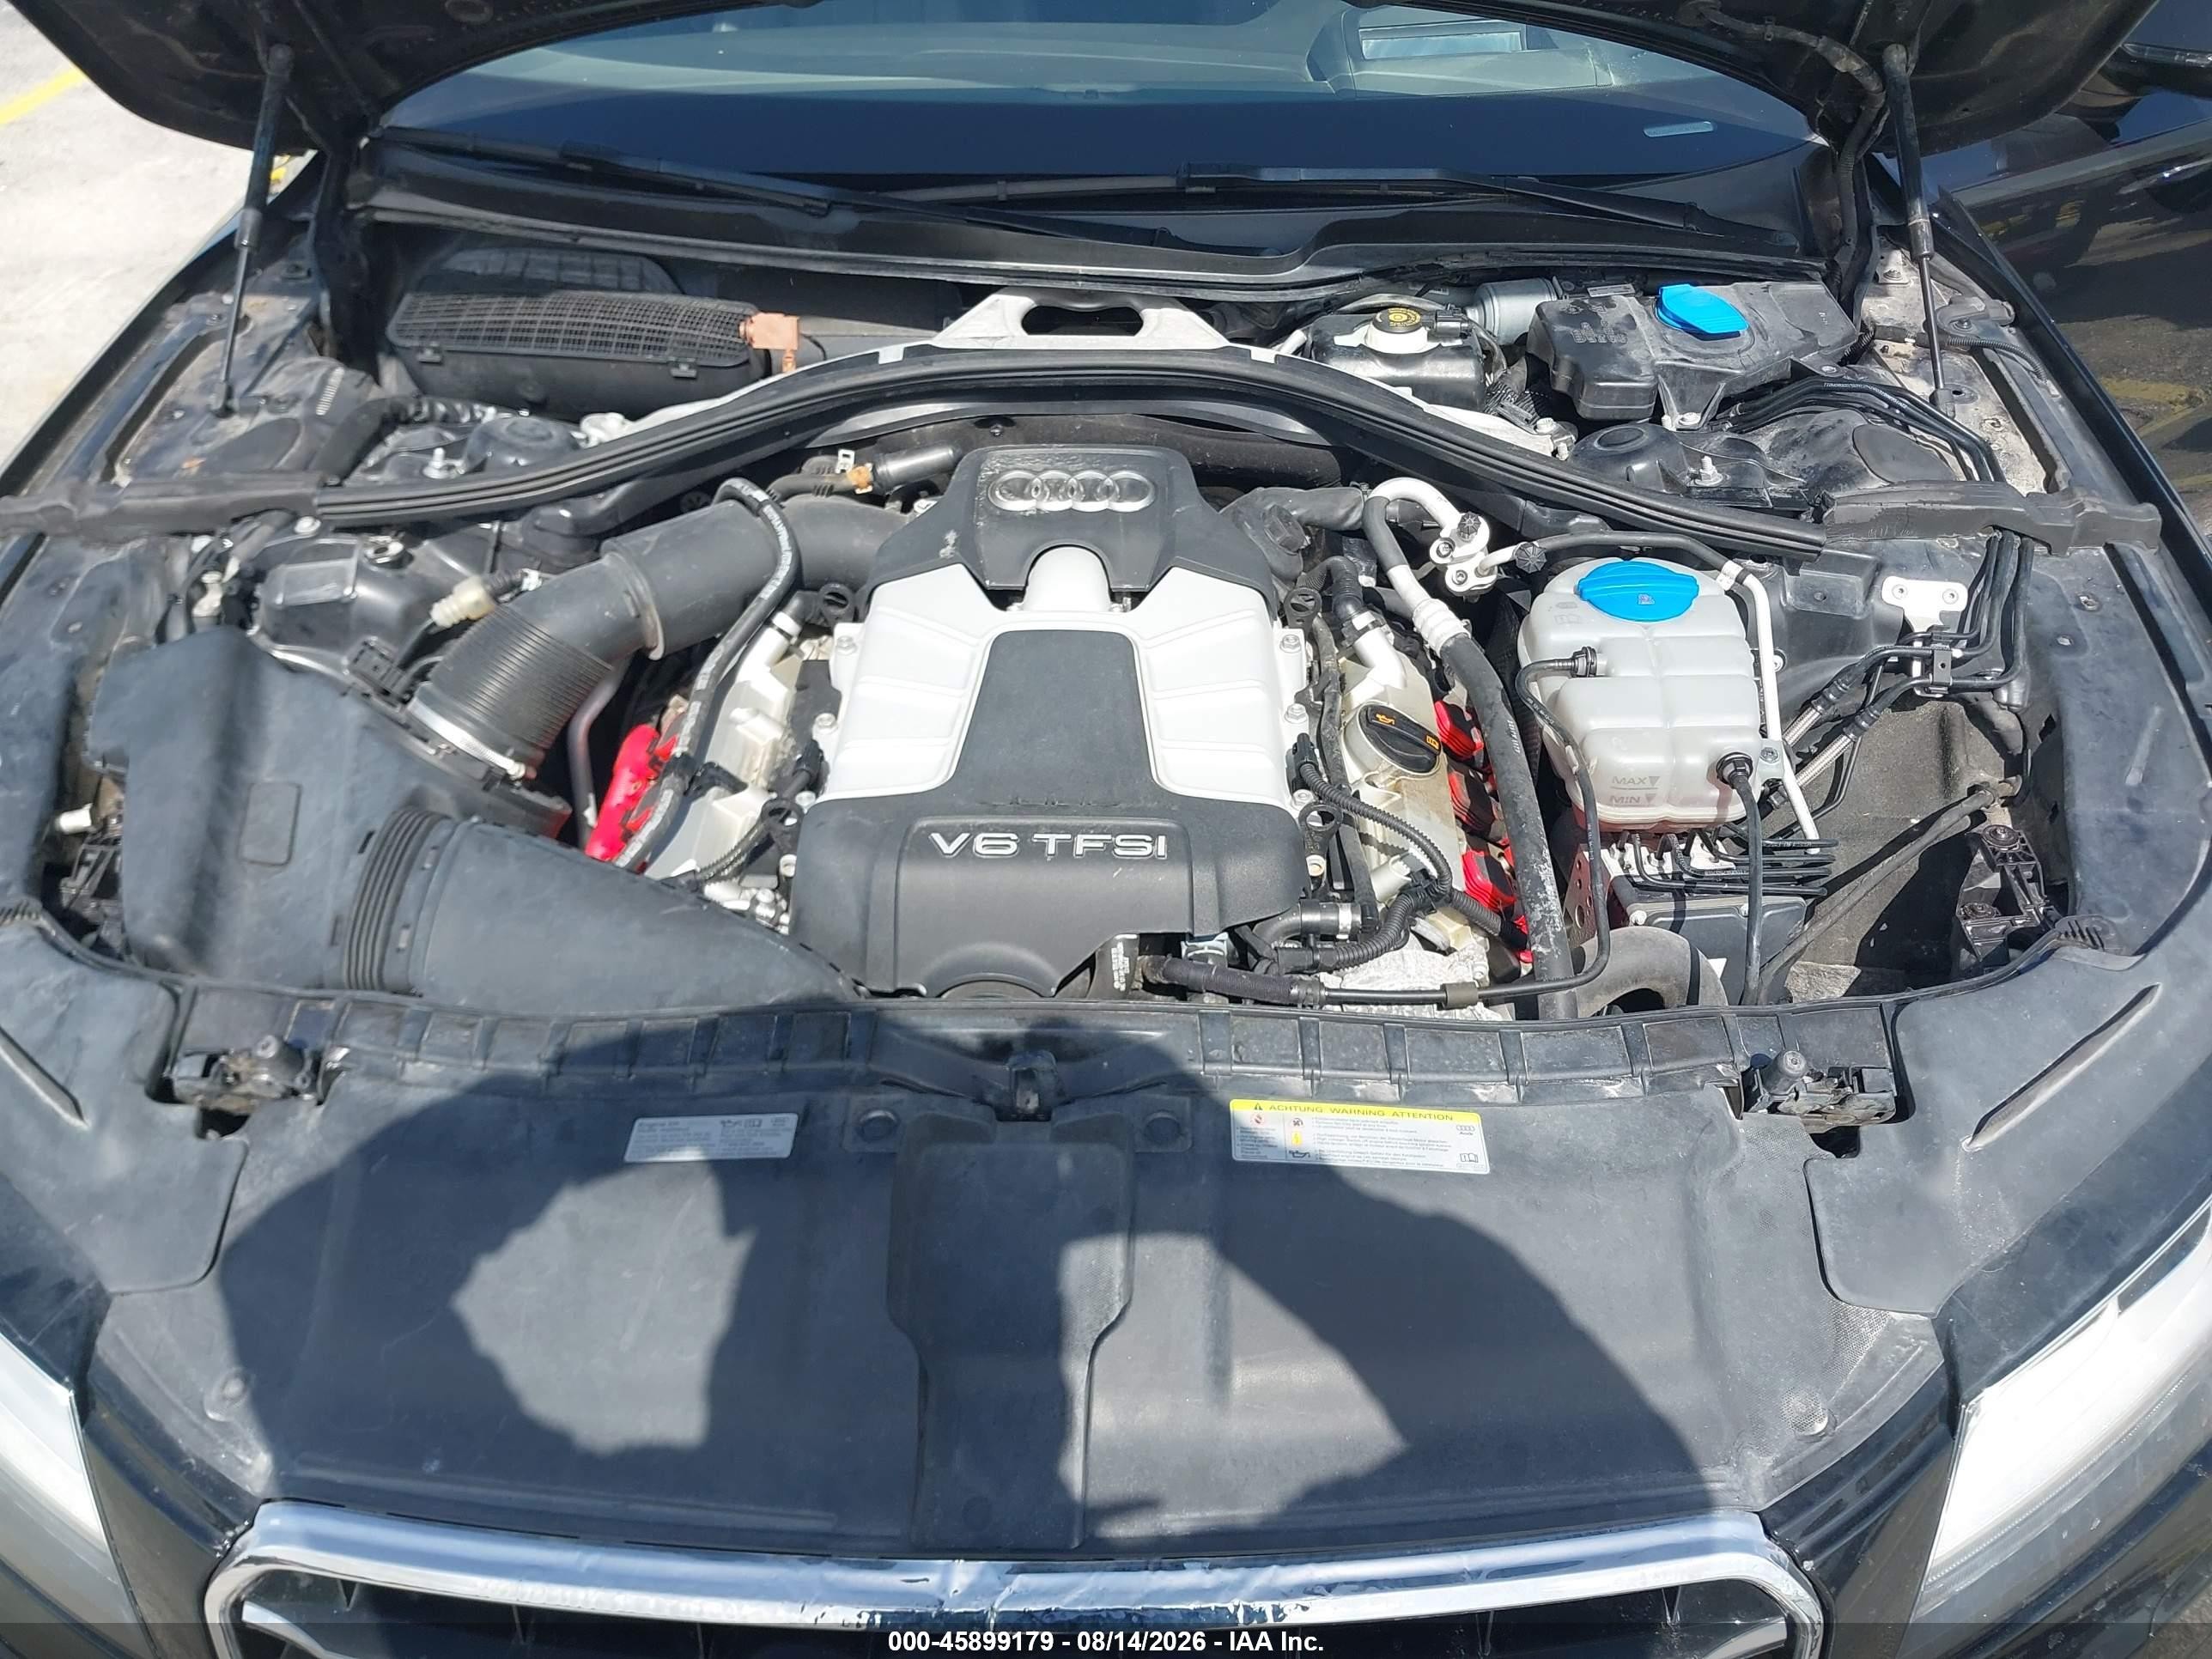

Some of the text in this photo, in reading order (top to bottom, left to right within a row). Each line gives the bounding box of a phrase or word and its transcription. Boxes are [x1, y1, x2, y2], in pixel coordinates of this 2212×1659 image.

[1611, 775, 1648, 785] MAX
[1609, 795, 1641, 804] MIN
[929, 832, 1168, 859] V6 TFSI
[1268, 1104, 1454, 1121] ACHTUNG WARNING ATTENTION
